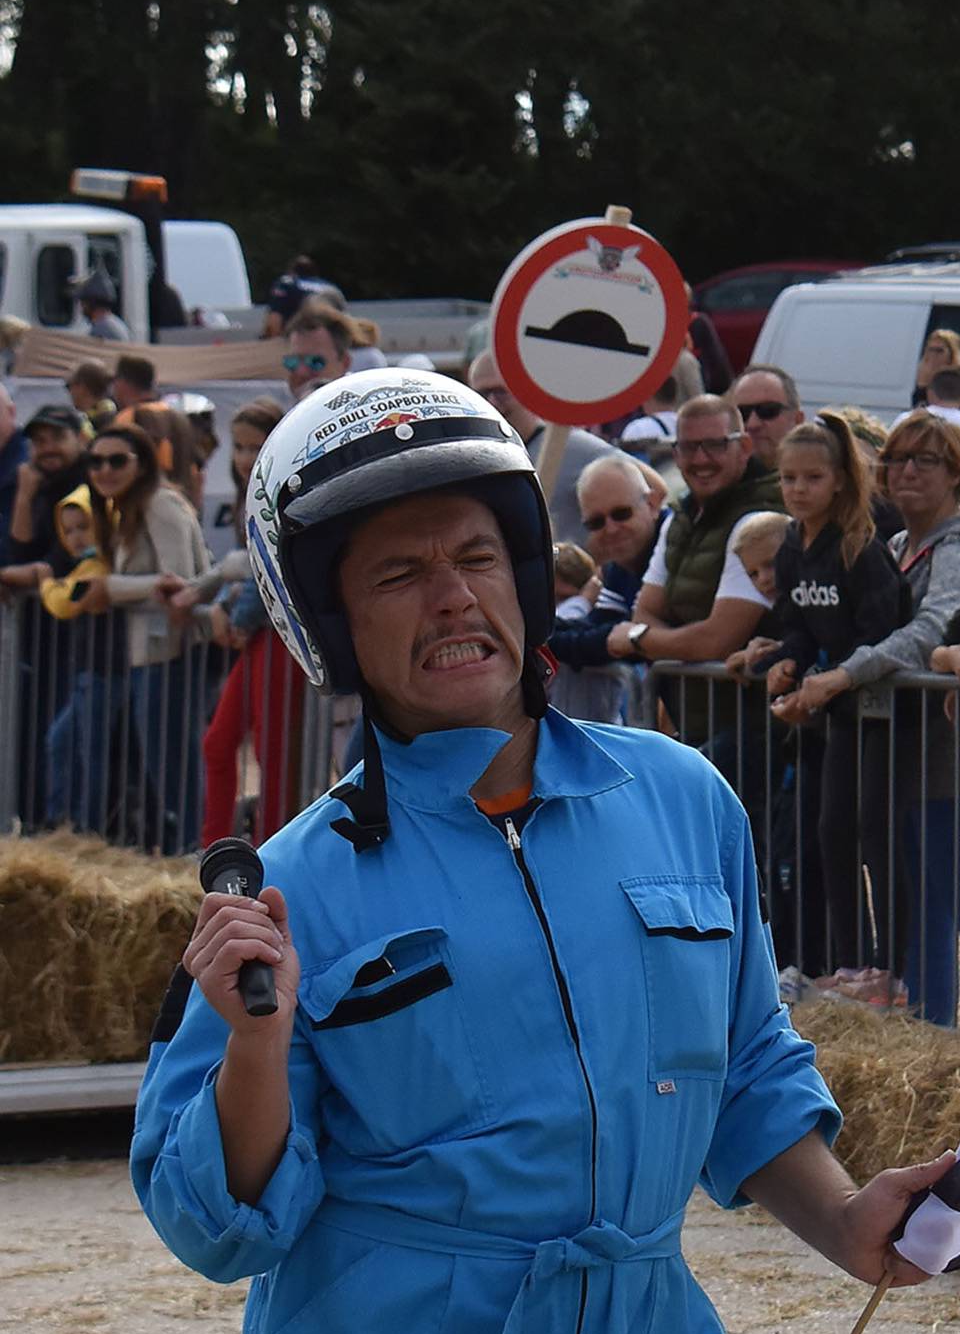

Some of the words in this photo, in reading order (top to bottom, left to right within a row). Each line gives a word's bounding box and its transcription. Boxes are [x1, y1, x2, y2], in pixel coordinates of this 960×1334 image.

[314, 423, 337, 442] RED
[339, 409, 367, 429] BULL
[370, 395, 430, 415] SOAPBOX
[432, 395, 461, 405] RACE
